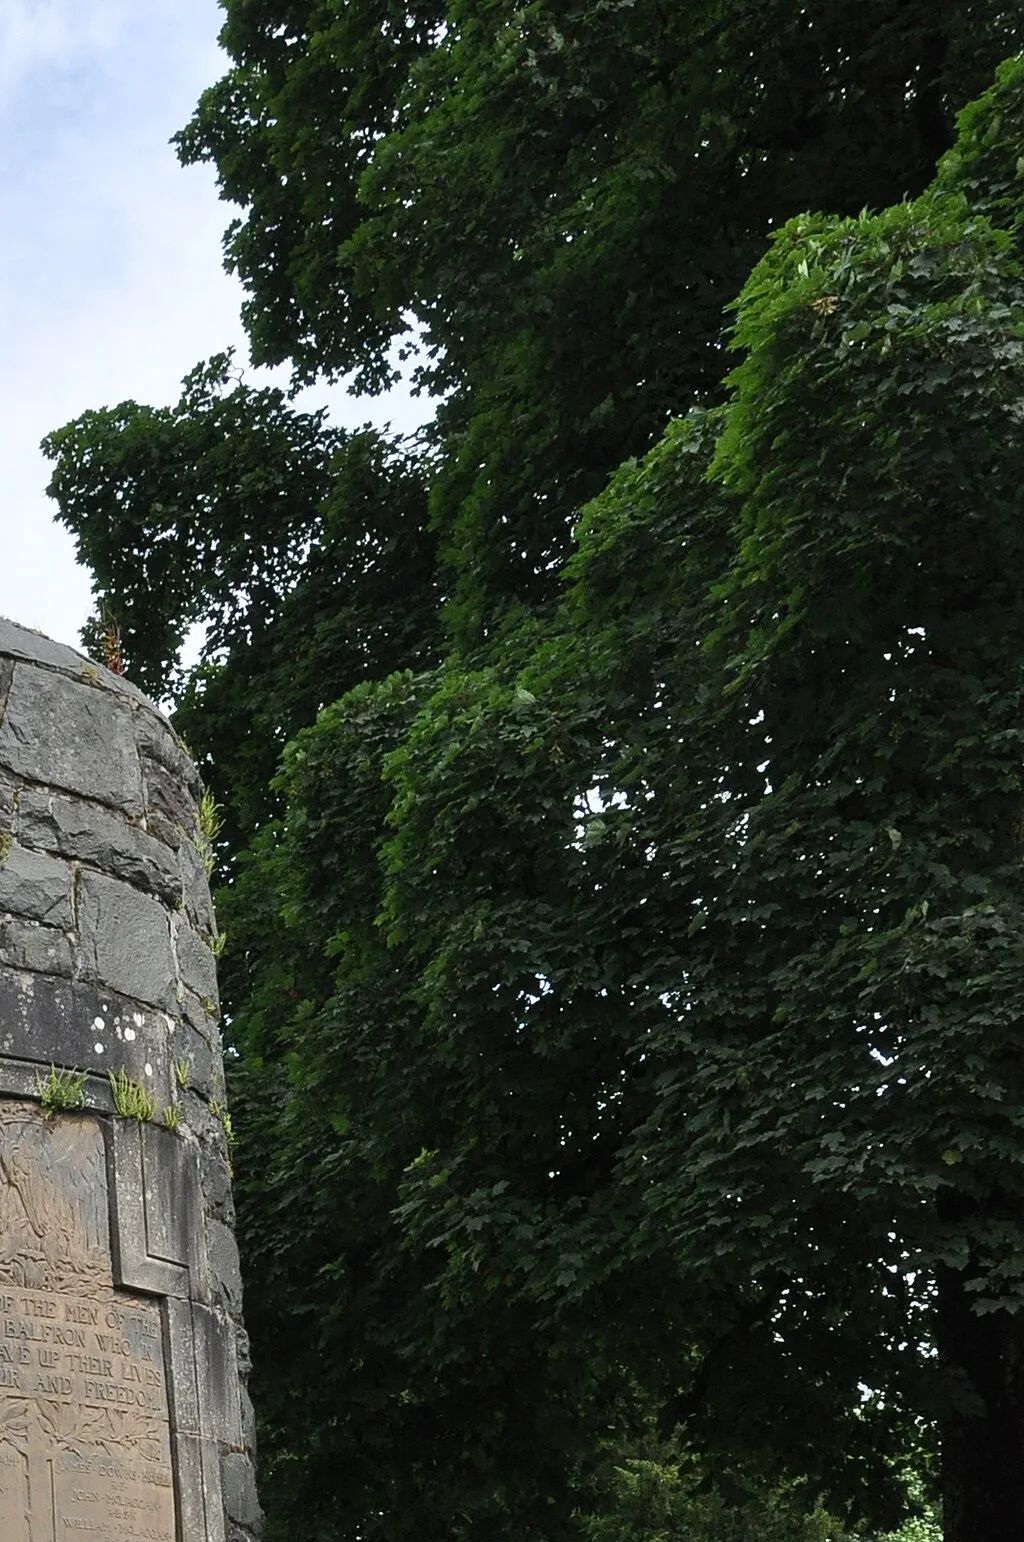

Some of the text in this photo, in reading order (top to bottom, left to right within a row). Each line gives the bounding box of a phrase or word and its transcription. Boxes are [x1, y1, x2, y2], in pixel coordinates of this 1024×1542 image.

[23, 1298, 57, 1318] THE
[65, 1303, 98, 1325] MEN
[106, 1310, 125, 1330] OF
[131, 1317, 157, 1339] THE
[4, 1320, 85, 1348] BALFRON
[95, 1333, 131, 1357] WHO
[140, 1343, 152, 1362] IN
[33, 1373, 73, 1395] AND
[37, 1348, 60, 1368] UP
[65, 1353, 113, 1377] THEIR
[121, 1362, 161, 1387] LIVES
